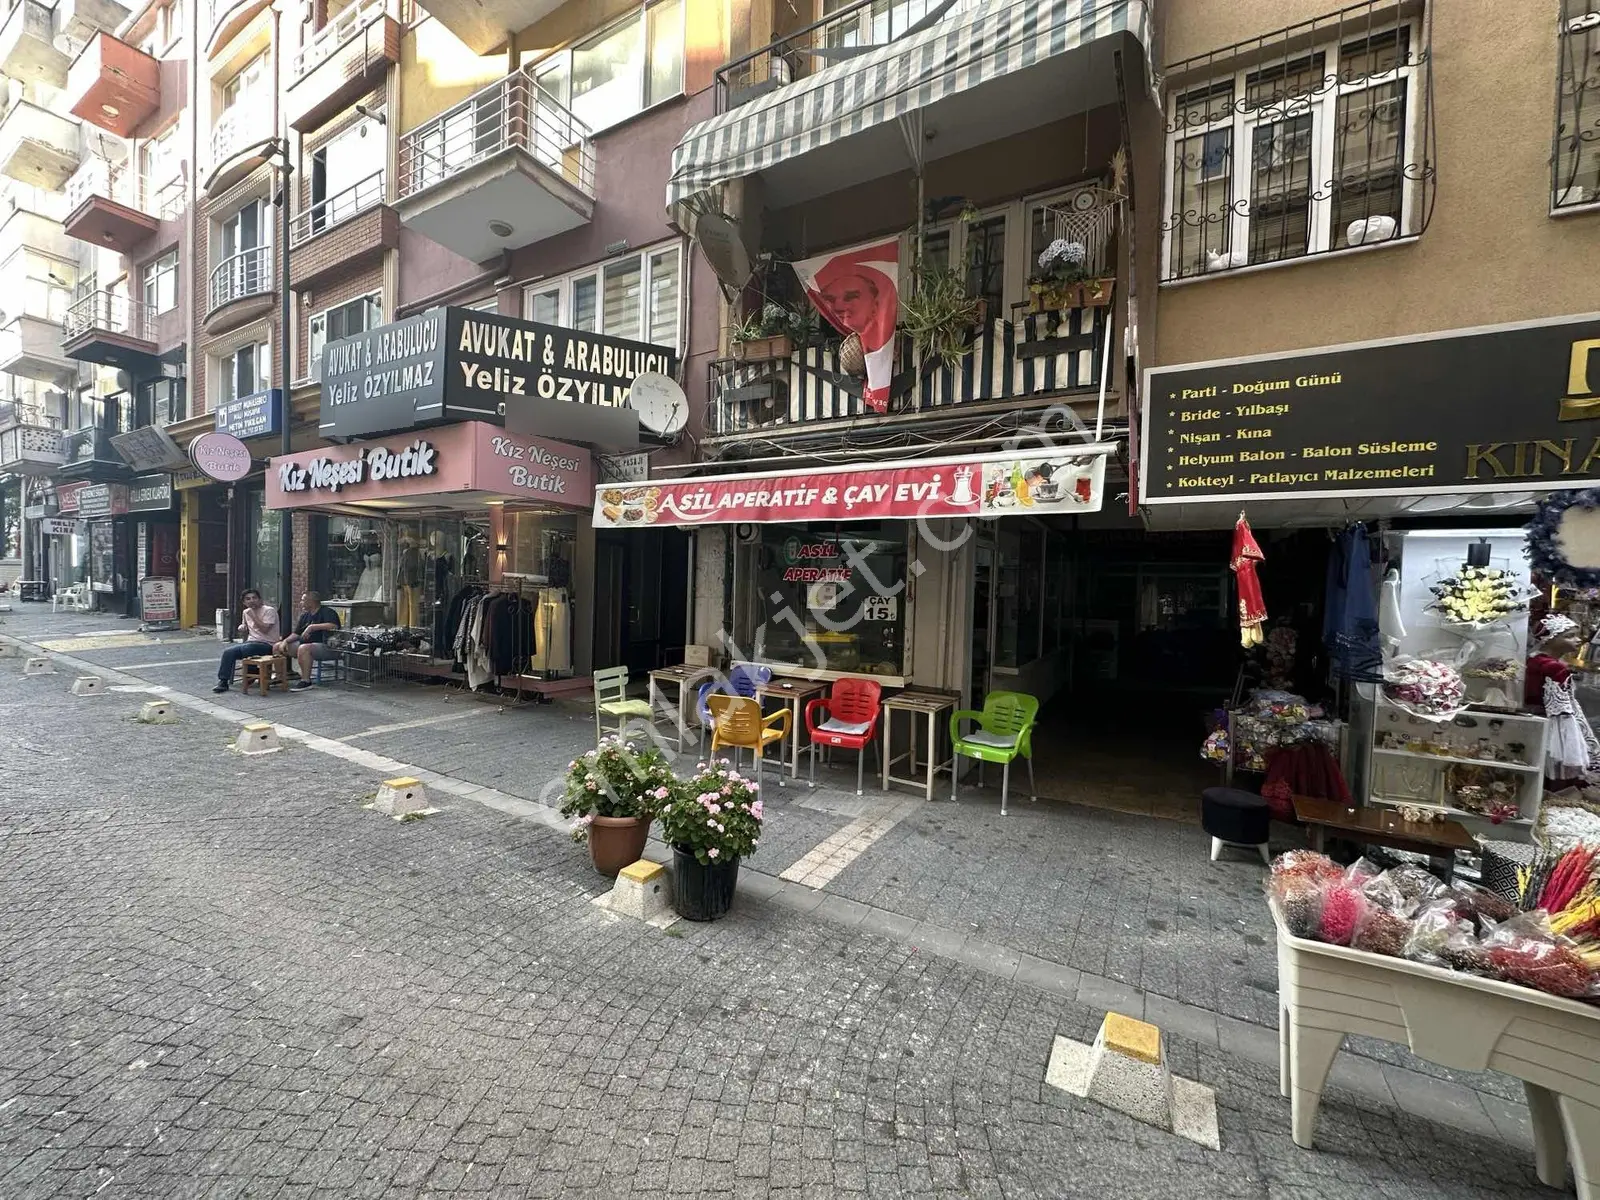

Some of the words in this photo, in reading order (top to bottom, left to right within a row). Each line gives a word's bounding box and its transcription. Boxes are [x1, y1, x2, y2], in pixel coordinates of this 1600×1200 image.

[328, 341, 361, 377] AVUKAT
[365, 338, 371, 367] &
[377, 318, 438, 365] ARABULUCU
[459, 320, 536, 362] AVUKAT
[543, 334, 554, 366] &
[329, 381, 358, 406] Yeliz
[364, 361, 434, 399] ÖZYILMAZ
[460, 362, 526, 395] Yeliz
[537, 367, 632, 408] ÖZYILM
[1182, 386, 1217, 400] Parti
[1232, 380, 1290, 394] Doğum
[1295, 372, 1342, 387] Günü
[1181, 409, 1221, 422] Bride
[1235, 404, 1290, 416] Yılbaşı
[1180, 433, 1220, 445] Nişan
[1236, 428, 1272, 439] Kına
[198, 443, 214, 456] Kız
[217, 446, 246, 459] Neşesi
[492, 436, 523, 460] Kız
[528, 446, 580, 472] Neşesi
[1179, 454, 1234, 466] Helyum
[1240, 451, 1286, 462] Balon
[1302, 446, 1352, 458] Balon
[1358, 442, 1438, 455] Süsleme
[207, 461, 240, 472] Butik
[280, 462, 305, 492] Kız
[309, 450, 363, 493] Neşesi
[367, 440, 434, 481] Butik
[509, 466, 565, 494] Butik
[1178, 475, 1234, 488] Kokteyl
[1250, 472, 1318, 485] Patlayıcı
[1324, 465, 1434, 480] Malzemeleri
[717, 482, 818, 510] APERATİF
[822, 487, 838, 505] &
[844, 484, 890, 510] ÇAY
[895, 474, 941, 501] EVİ
[797, 540, 839, 558] ASİL
[869, 596, 890, 606] ÇAY
